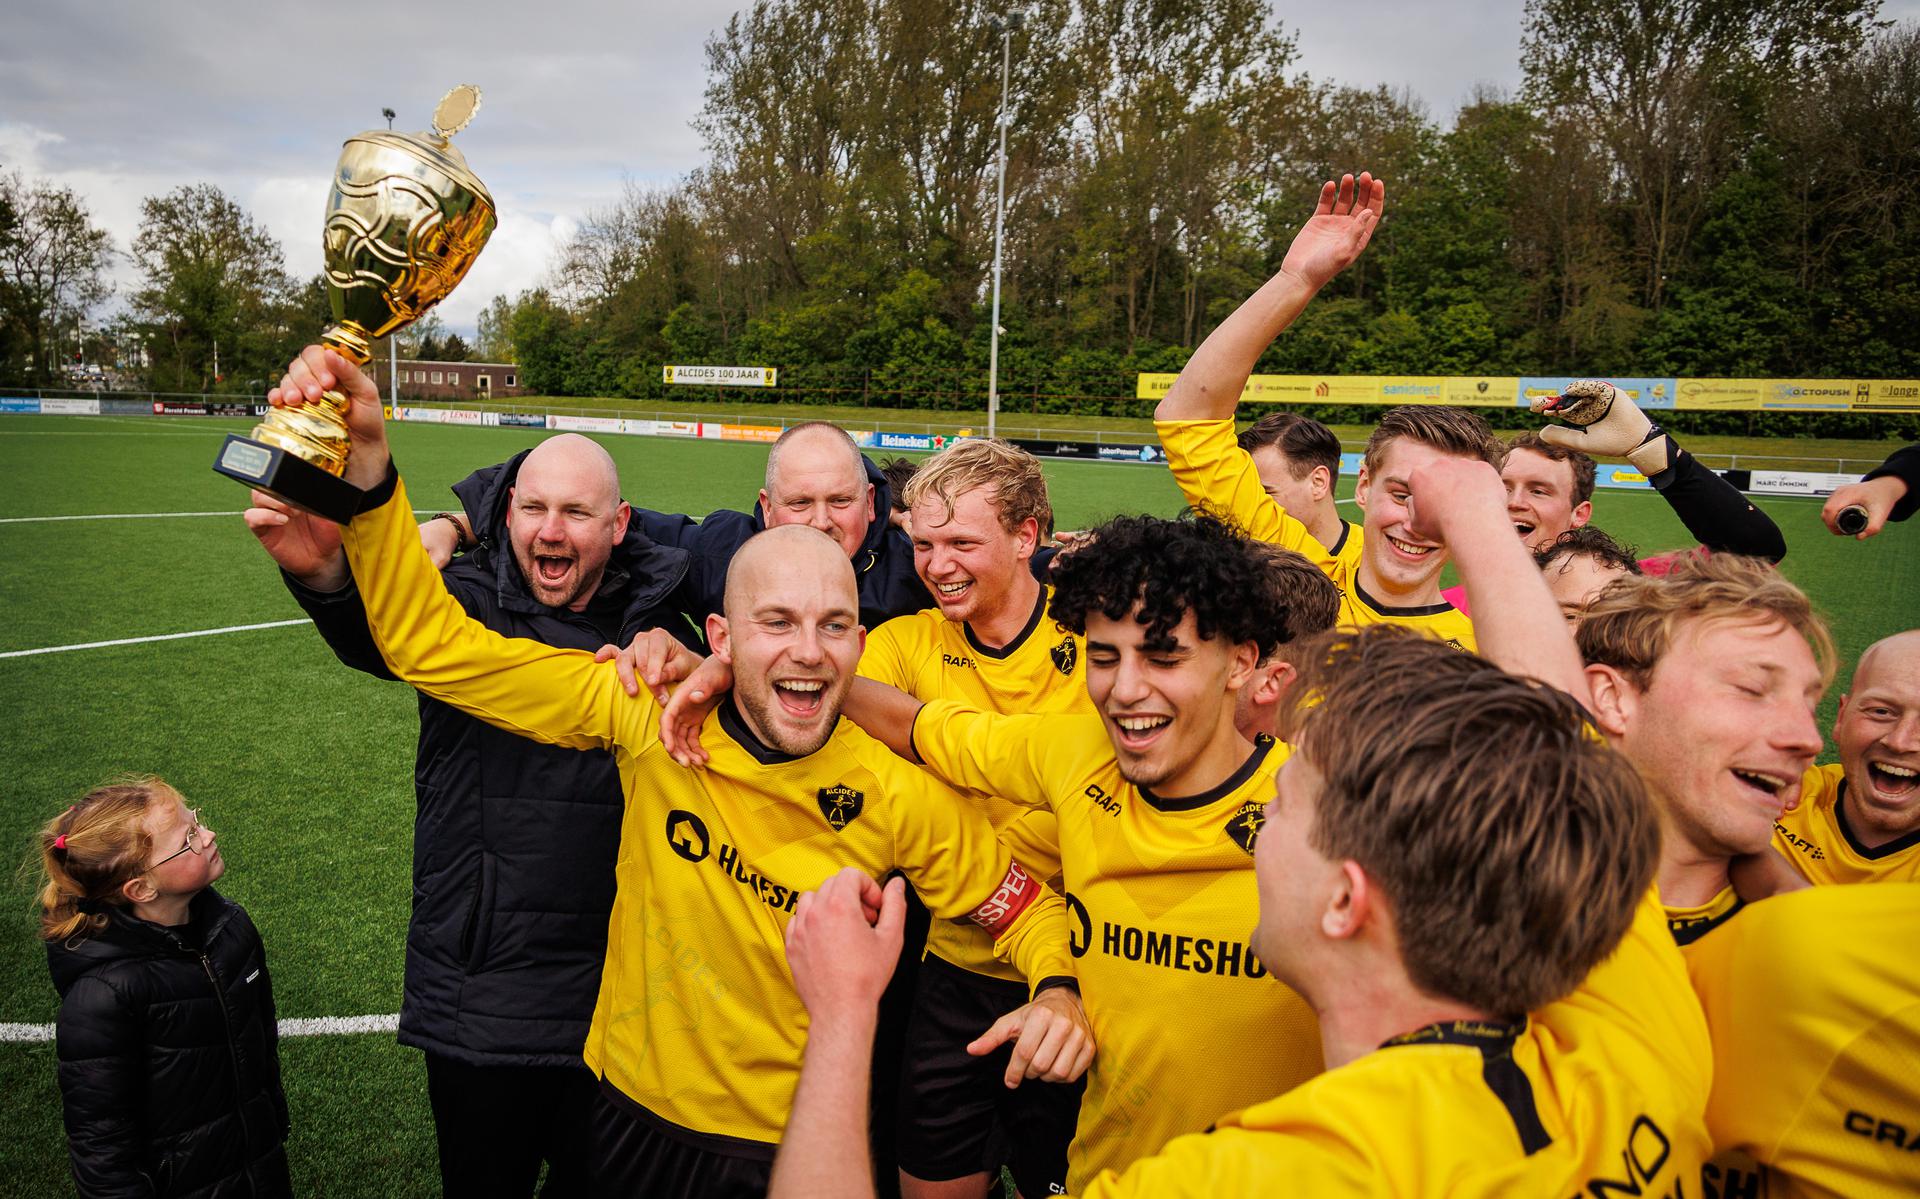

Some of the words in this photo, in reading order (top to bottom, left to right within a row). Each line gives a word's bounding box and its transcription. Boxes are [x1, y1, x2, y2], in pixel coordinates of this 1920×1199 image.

[677, 369, 715, 378] ALCIDES
[718, 369, 734, 378] 100
[736, 370, 760, 379] JAAR
[1383, 382, 1441, 396] sanidirect
[1792, 388, 1850, 396] OCTOPUSH
[881, 434, 930, 448] Heineken
[826, 788, 857, 798] ALCIDES
